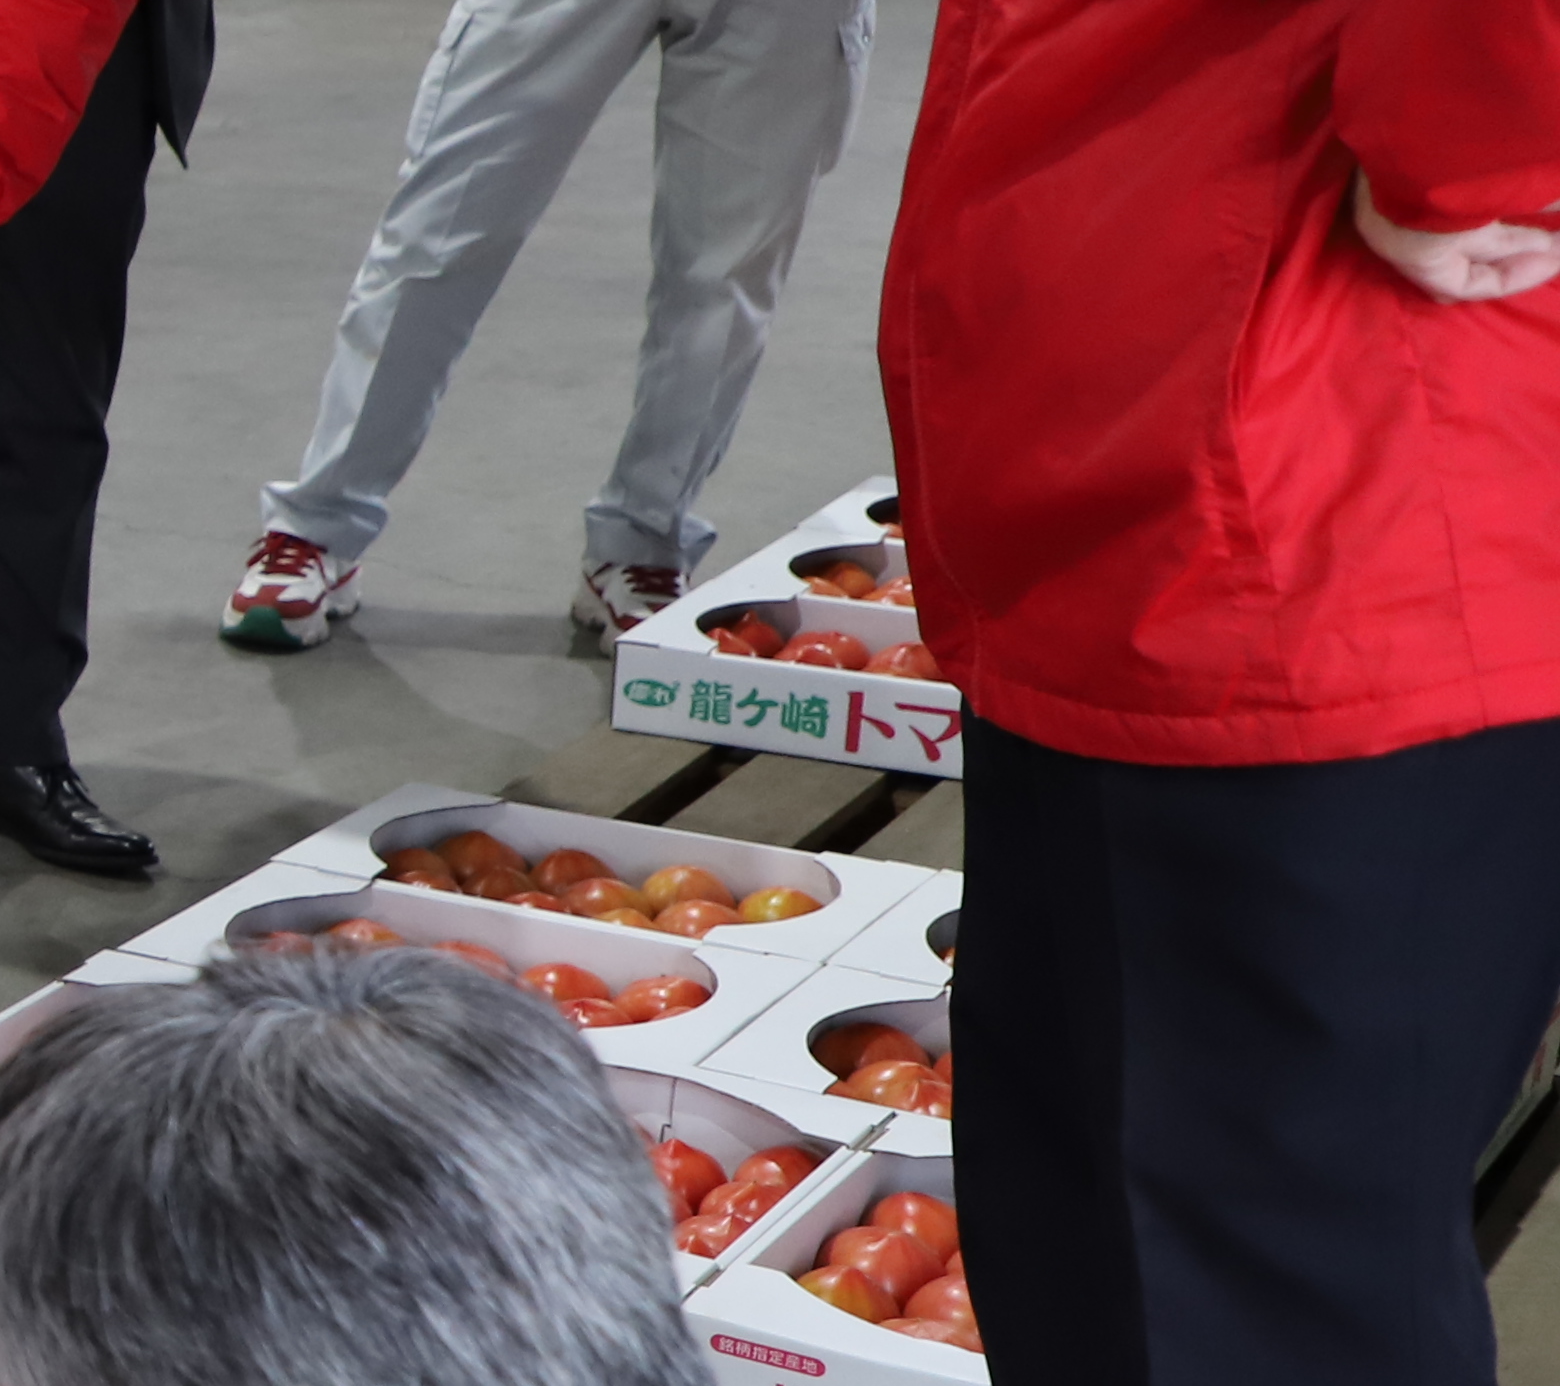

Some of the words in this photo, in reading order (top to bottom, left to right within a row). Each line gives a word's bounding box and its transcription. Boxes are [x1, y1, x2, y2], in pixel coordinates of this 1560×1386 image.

[719, 1336, 820, 1375] 銘柄指定産地
